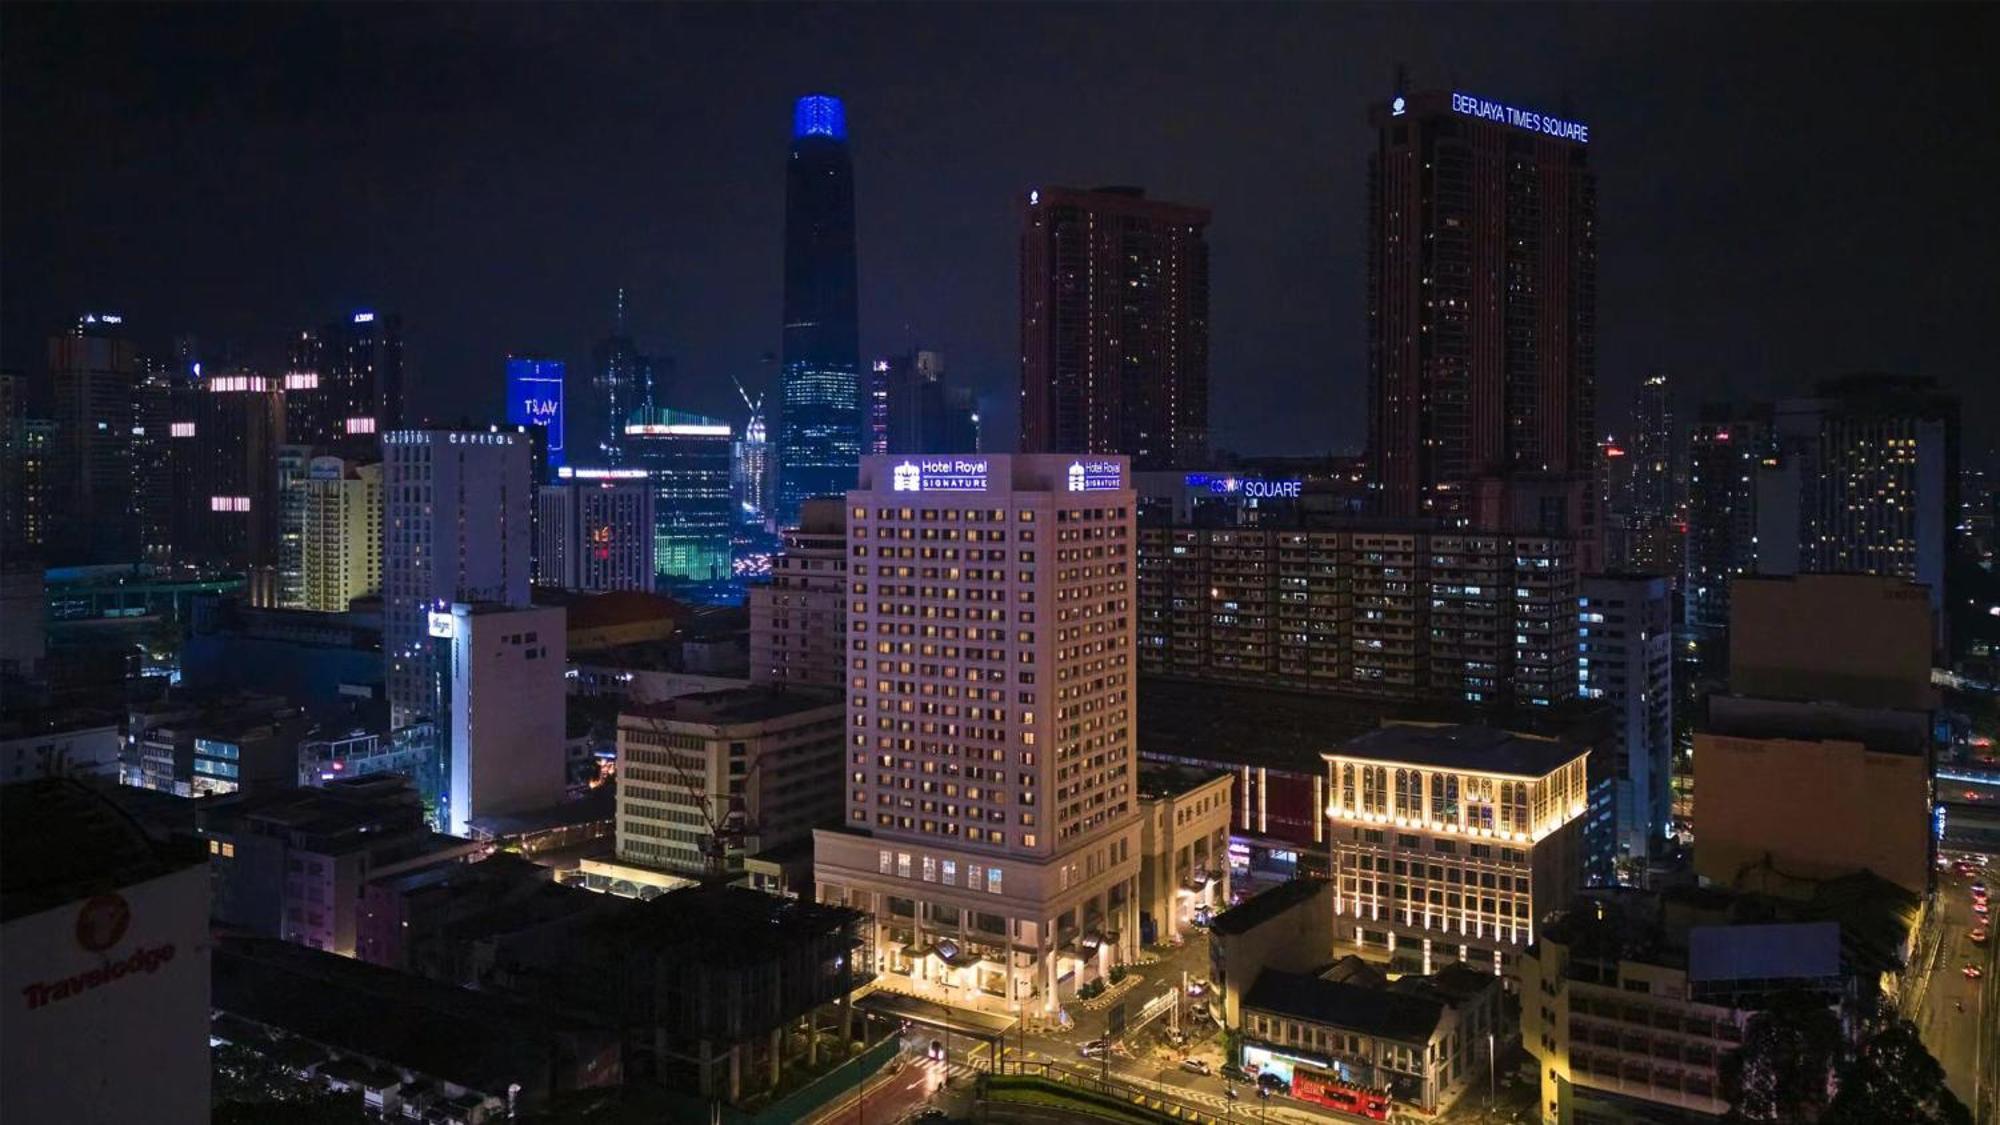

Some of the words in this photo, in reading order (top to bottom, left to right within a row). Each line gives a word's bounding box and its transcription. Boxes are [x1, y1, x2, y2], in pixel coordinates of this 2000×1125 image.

[1452, 92, 1505, 123] BERJAYA
[1505, 107, 1541, 132] TIMES
[1542, 116, 1589, 143] SQUARE
[922, 460, 953, 473] Hotel
[955, 461, 987, 475] Royal
[922, 479, 988, 488] SIGNATURE
[1244, 481, 1302, 497] SQUARE
[21, 943, 176, 1009] Travelodge
